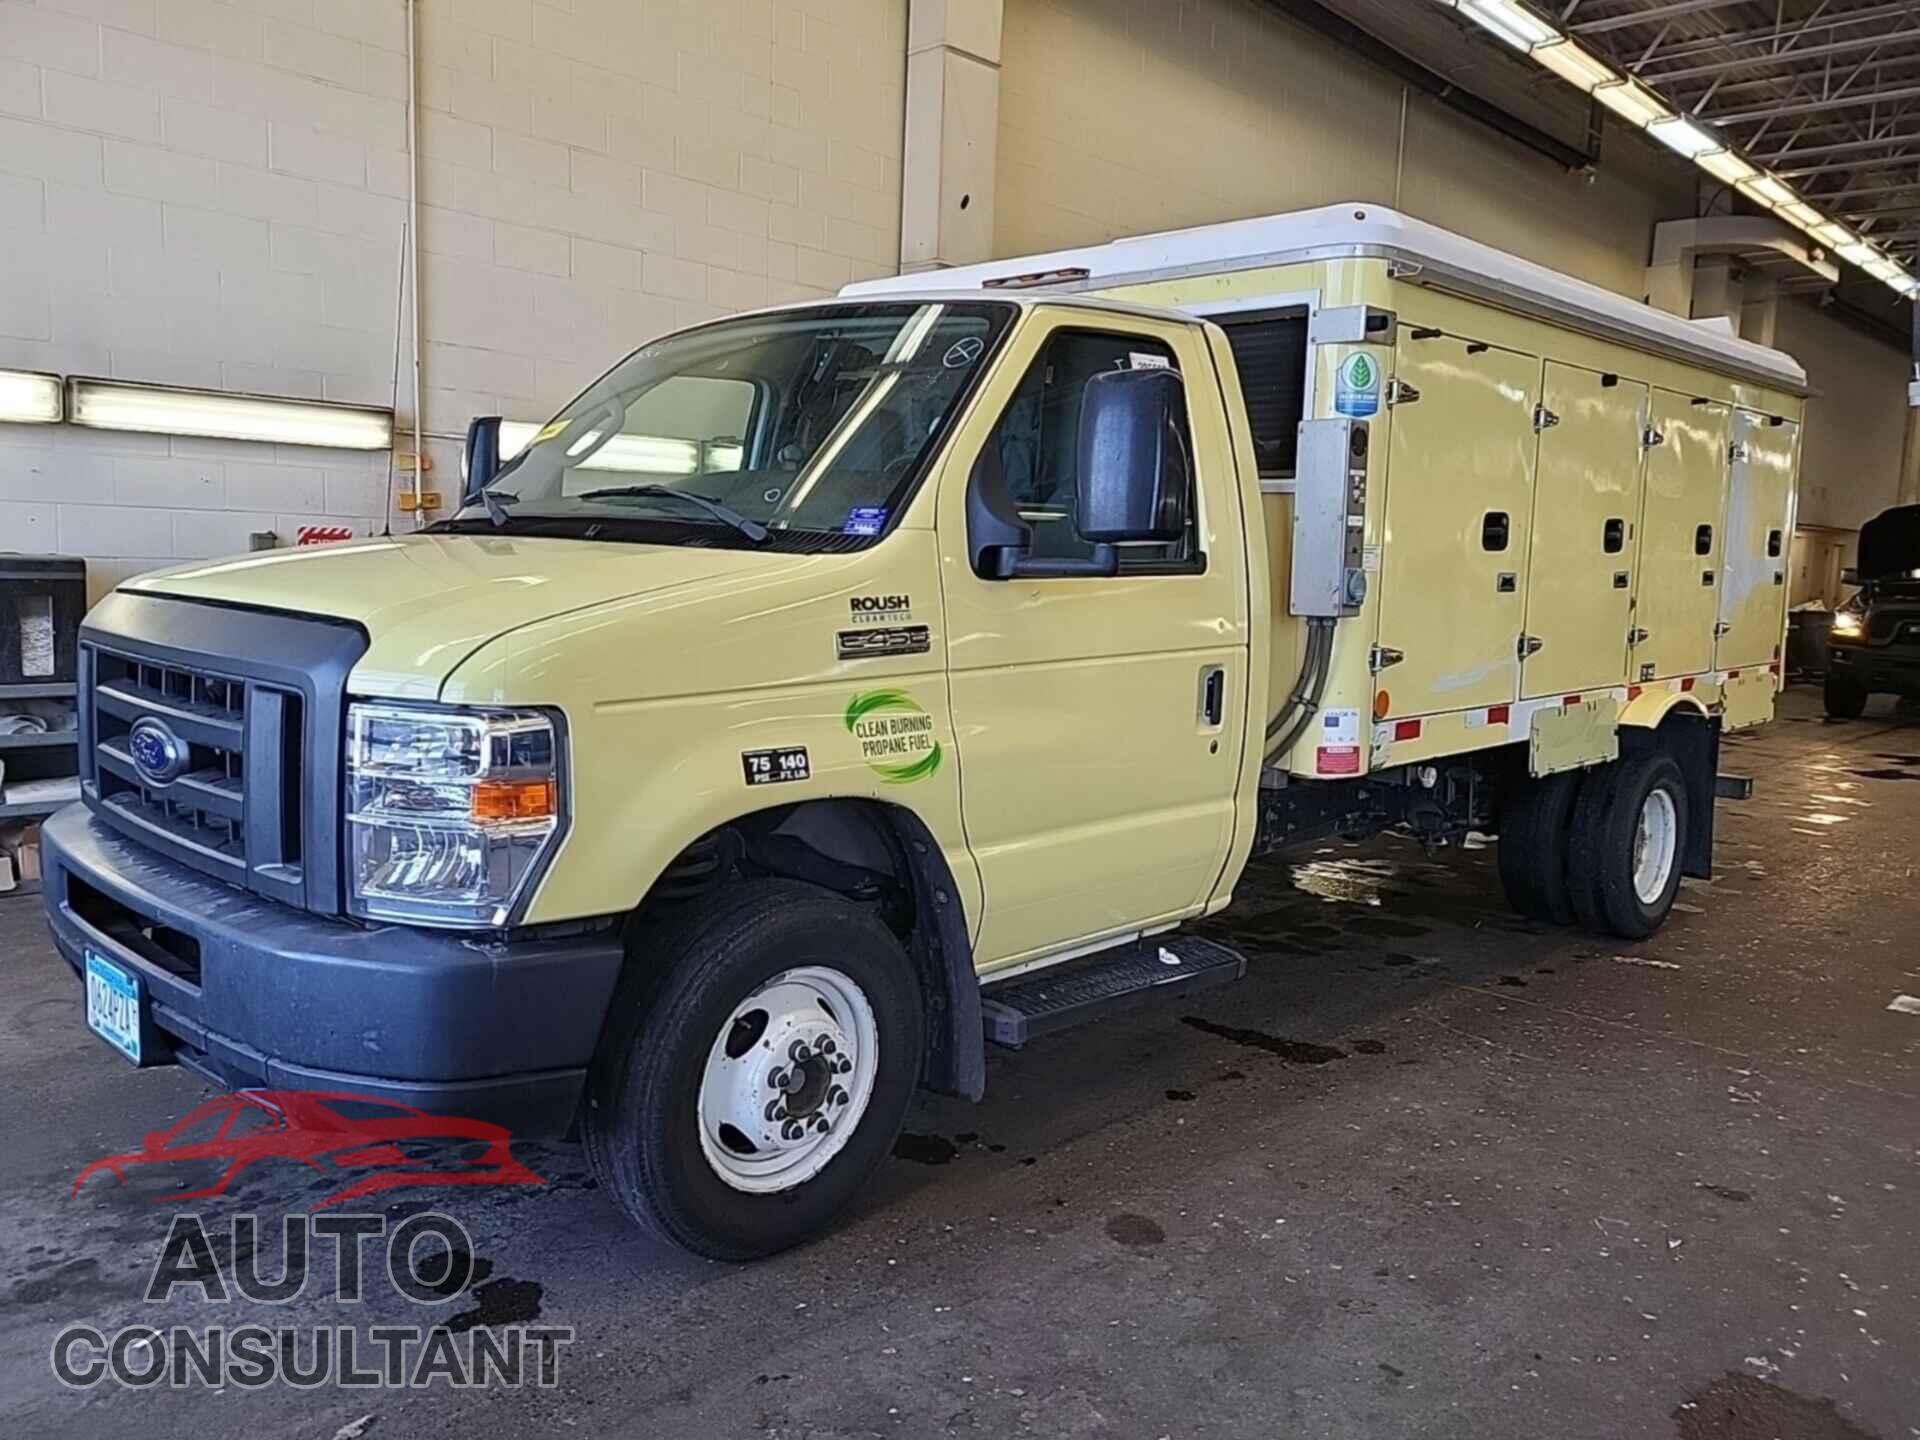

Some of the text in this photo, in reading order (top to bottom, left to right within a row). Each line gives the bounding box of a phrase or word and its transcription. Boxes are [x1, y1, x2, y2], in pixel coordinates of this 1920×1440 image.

[850, 594, 910, 611] ROUSH
[856, 715, 932, 738] CLEAN BURNING
[862, 733, 933, 757] PROPANE FUEL
[749, 753, 806, 772] 75 140
